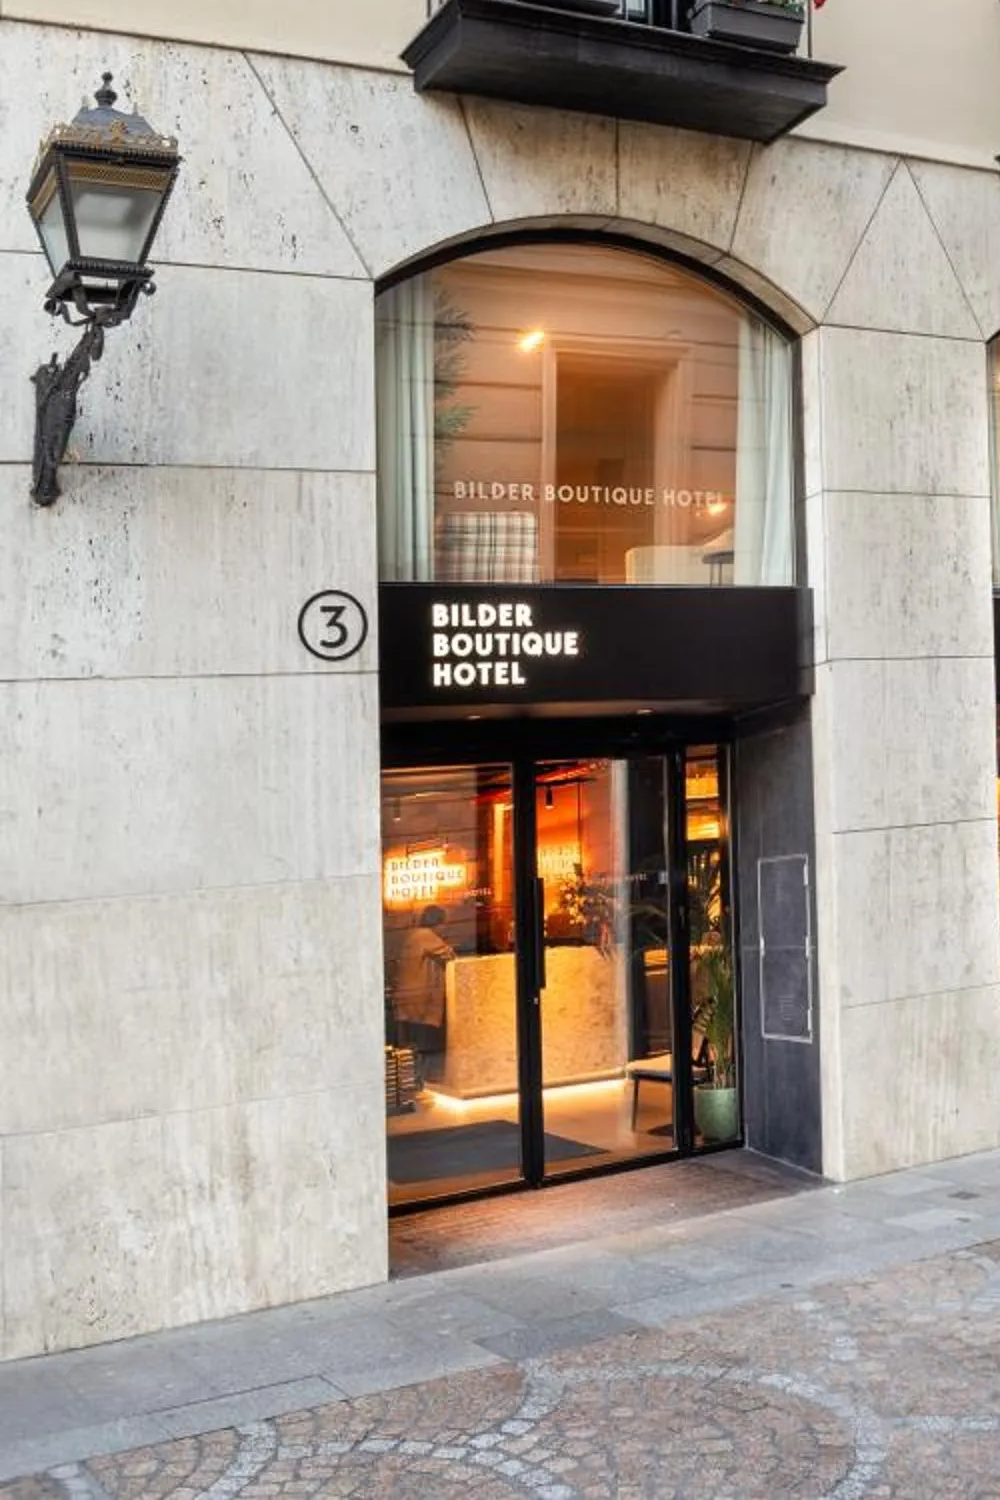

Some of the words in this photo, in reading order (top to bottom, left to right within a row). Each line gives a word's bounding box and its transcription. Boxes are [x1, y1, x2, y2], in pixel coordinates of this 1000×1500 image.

[454, 480, 534, 501] BILDER
[544, 484, 654, 506] BOUTIQUE
[319, 605, 348, 649] 3
[433, 604, 532, 627] BILDER
[434, 632, 578, 656] BOUTIQUE
[434, 662, 525, 686] HOTEL
[391, 869, 464, 884] BOUTIQUE
